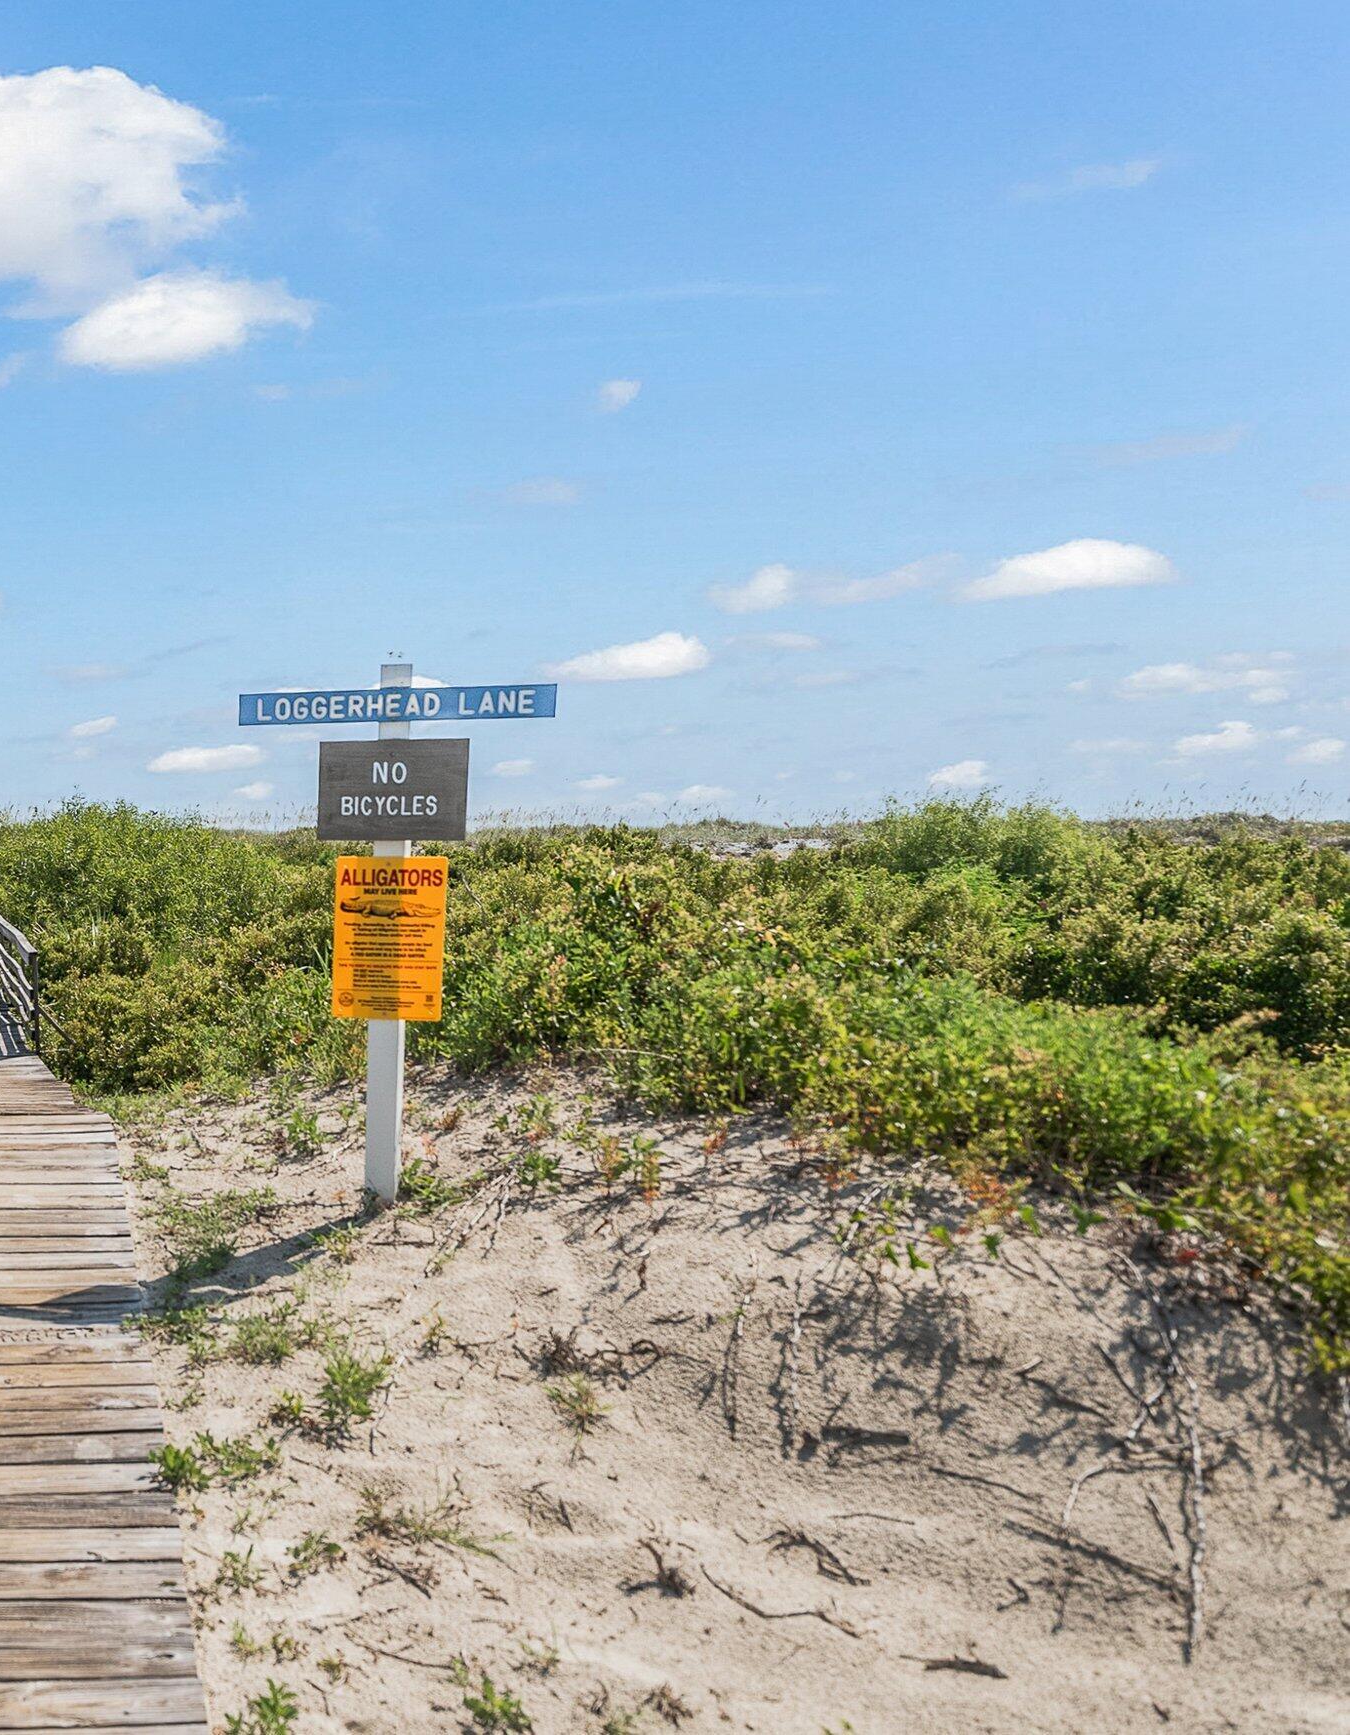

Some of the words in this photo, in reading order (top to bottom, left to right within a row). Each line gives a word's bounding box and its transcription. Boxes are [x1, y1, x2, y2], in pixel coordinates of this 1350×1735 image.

[257, 692, 440, 722] LOGGERHEAD
[458, 689, 537, 716] LANE
[372, 761, 407, 784] NO
[340, 795, 438, 817] BICYCLES
[340, 868, 443, 886] ALLIGATORS
